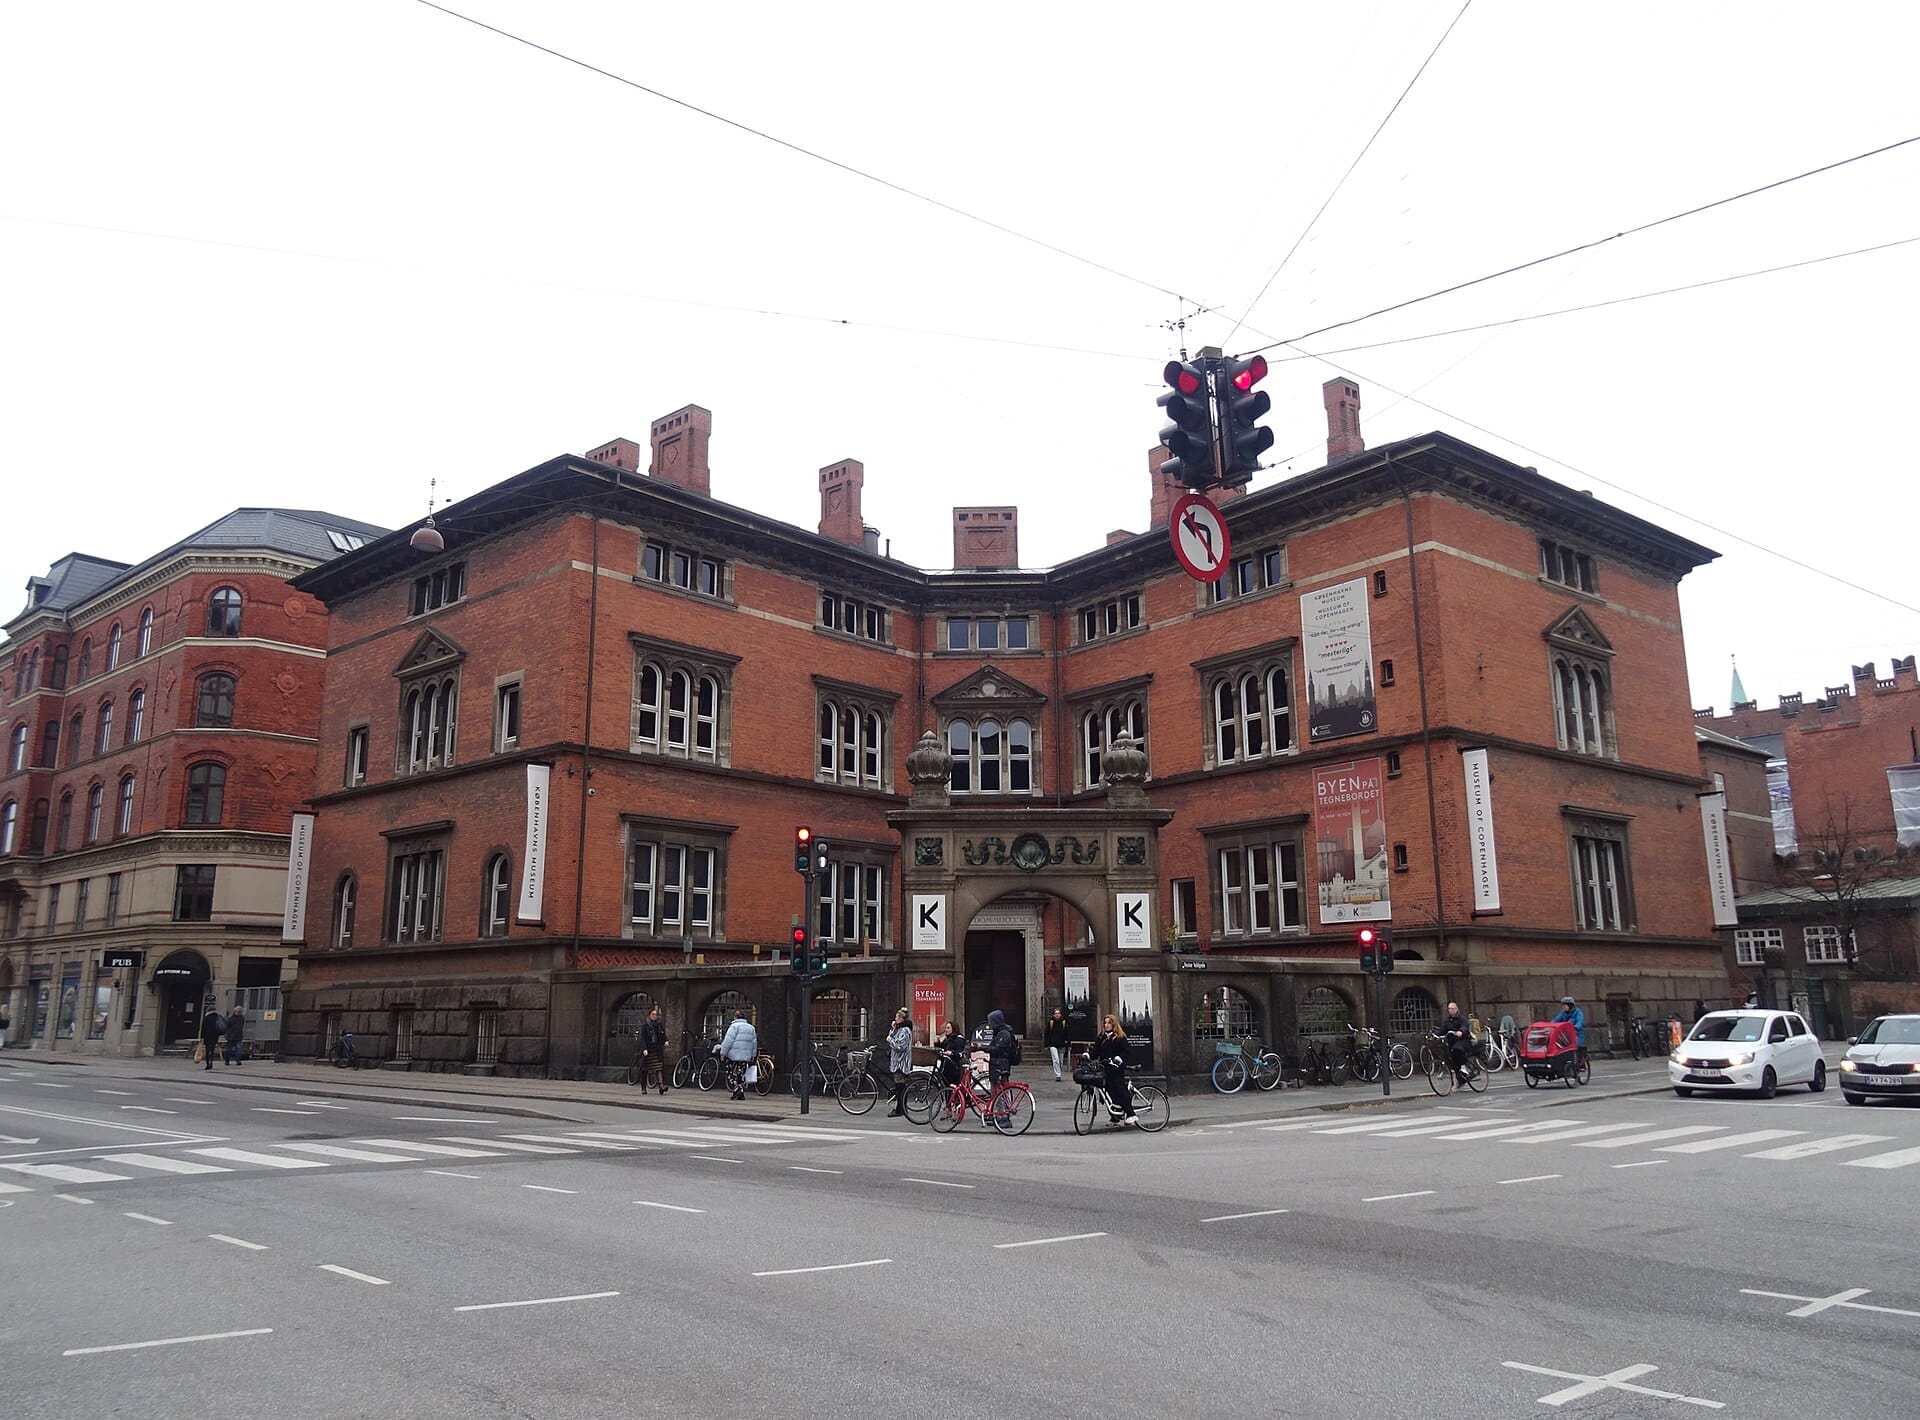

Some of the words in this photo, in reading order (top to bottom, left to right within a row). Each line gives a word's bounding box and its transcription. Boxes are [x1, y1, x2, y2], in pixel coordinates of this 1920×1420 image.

[1314, 587, 1352, 600] KØBENHAVNS
[1321, 595, 1345, 604] MUSEUM
[1315, 607, 1353, 620] COPENHAGEN
[1318, 604, 1341, 613] MUSEUM
[1311, 726, 1318, 736] K
[1317, 776, 1360, 796] BYEN
[1472, 763, 1482, 805] MUSEUM
[1319, 789, 1380, 805] TEGNEBORDET
[532, 786, 541, 853] KØBENHAVNS
[1476, 809, 1483, 821] OF
[298, 824, 306, 858] MUSEUM
[296, 861, 303, 871] OF
[1477, 826, 1490, 897] COPENHAGEN
[1710, 813, 1722, 869] KØBENHAVNS
[1718, 872, 1727, 908] MUSEUM
[528, 857, 537, 899] MUSEUM
[291, 874, 302, 931] COPENHAGEN
[920, 900, 938, 931] K
[1124, 899, 1143, 930] K
[1353, 908, 1359, 917] K
[915, 990, 936, 998] BYEN
[975, 1029, 983, 1040] K
